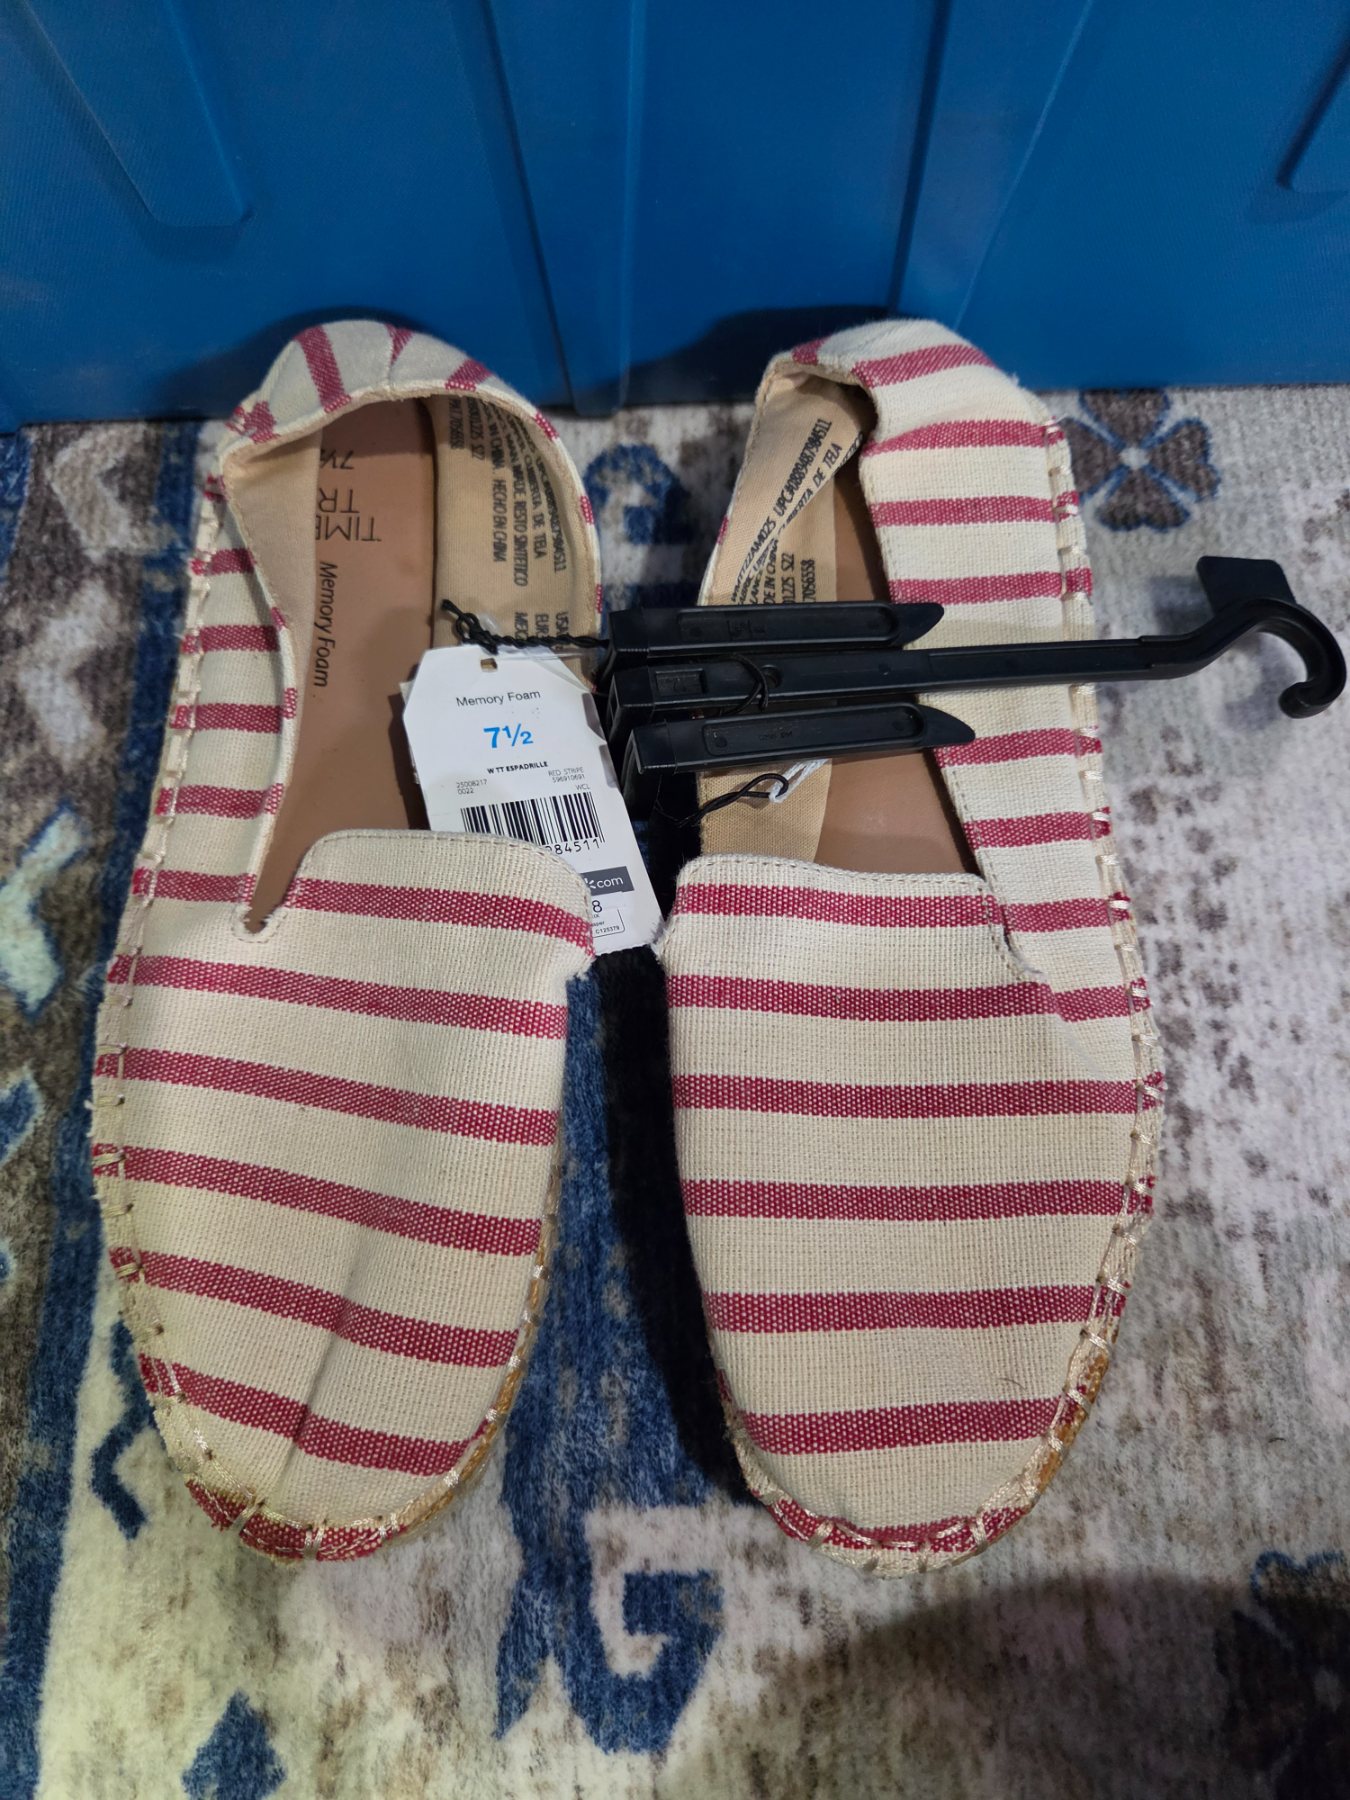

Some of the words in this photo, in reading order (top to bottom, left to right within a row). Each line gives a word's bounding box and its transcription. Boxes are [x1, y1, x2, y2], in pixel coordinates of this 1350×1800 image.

[812, 470, 827, 488] DE
[822, 442, 843, 469] TELA
[493, 479, 508, 515] HECHO
[493, 515, 507, 531] EN
[513, 501, 528, 533] RESTO
[533, 513, 546, 529] DE
[492, 531, 507, 563] CHINA
[533, 533, 548, 560] TELA
[313, 561, 338, 634] Memory
[312, 634, 336, 688] Foam
[456, 692, 505, 708] Memory
[507, 689, 541, 702] Foam
[487, 766, 495, 774] W
[496, 765, 505, 774] TT
[506, 761, 548, 773] ESPADRILLE
[457, 786, 475, 795] 0022
